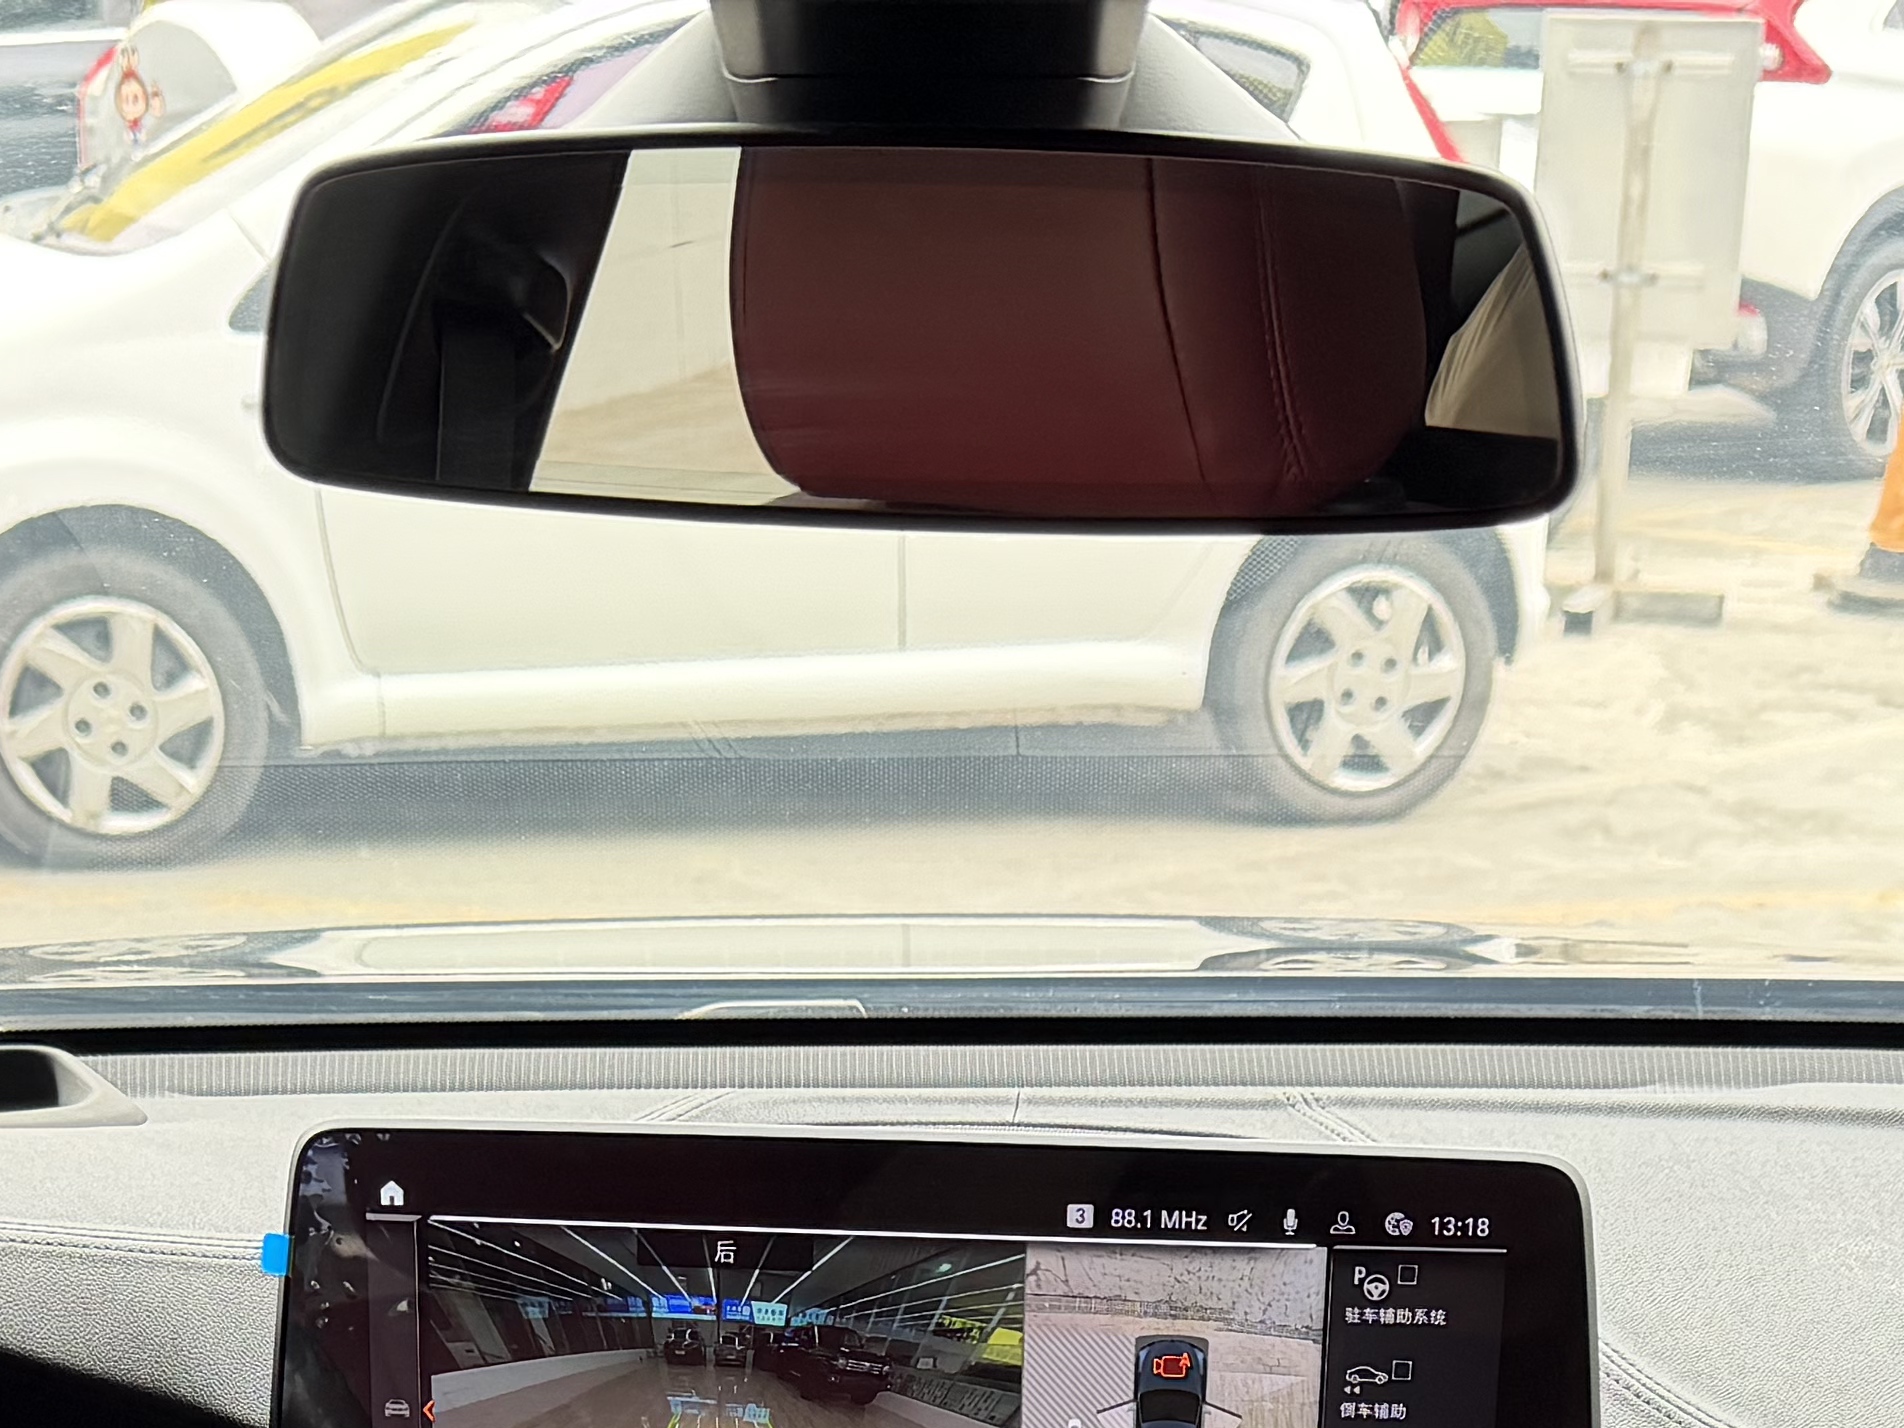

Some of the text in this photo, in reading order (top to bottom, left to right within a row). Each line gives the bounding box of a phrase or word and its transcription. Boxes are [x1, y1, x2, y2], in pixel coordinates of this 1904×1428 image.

[1074, 1209, 1086, 1224] 3
[1110, 1208, 1208, 1231] 88.1 MHz
[1430, 1216, 1491, 1237] 13:18
[714, 1240, 737, 1264] 后
[1344, 1307, 1449, 1327] 驻车辅助系统
[1339, 1402, 1407, 1420] 倒车辅助
